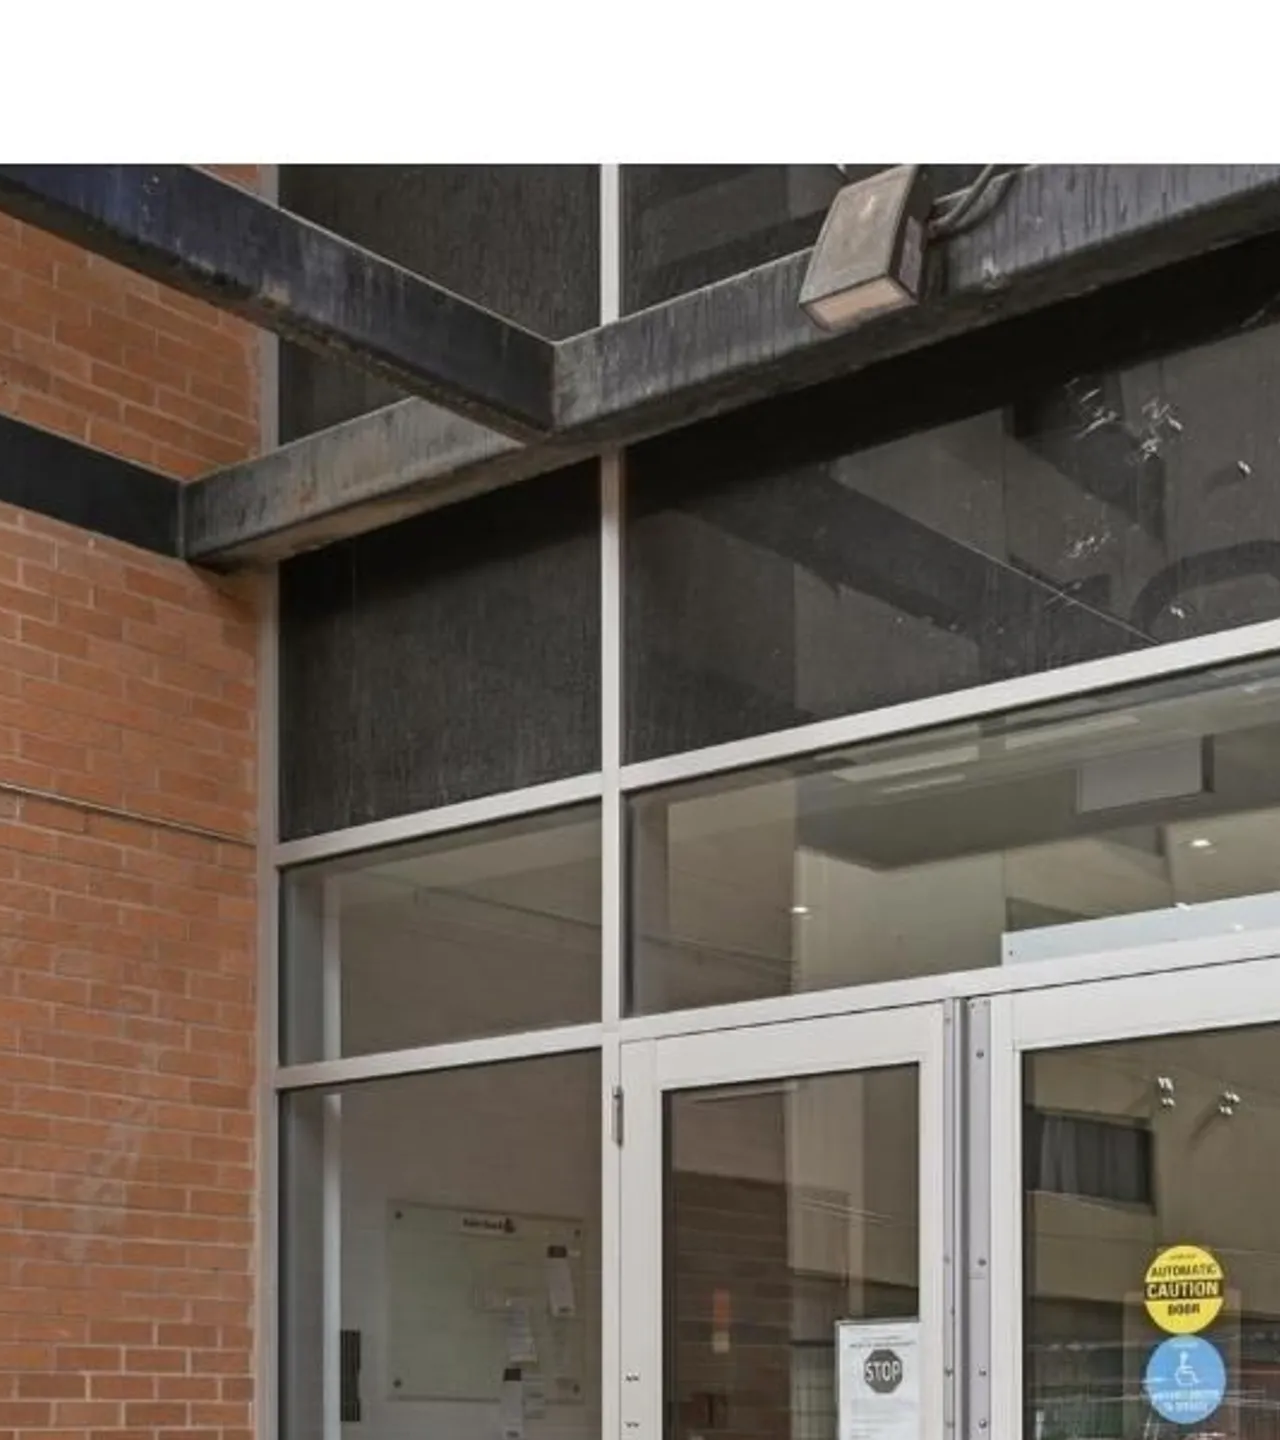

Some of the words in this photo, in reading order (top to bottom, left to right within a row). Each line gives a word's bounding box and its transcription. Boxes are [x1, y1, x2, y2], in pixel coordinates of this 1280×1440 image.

[1150, 1264, 1218, 1278] AUTOMATIC
[1147, 1281, 1219, 1298] CAUTION
[1167, 1302, 1201, 1317] DOOR
[865, 1360, 901, 1382] STOP
